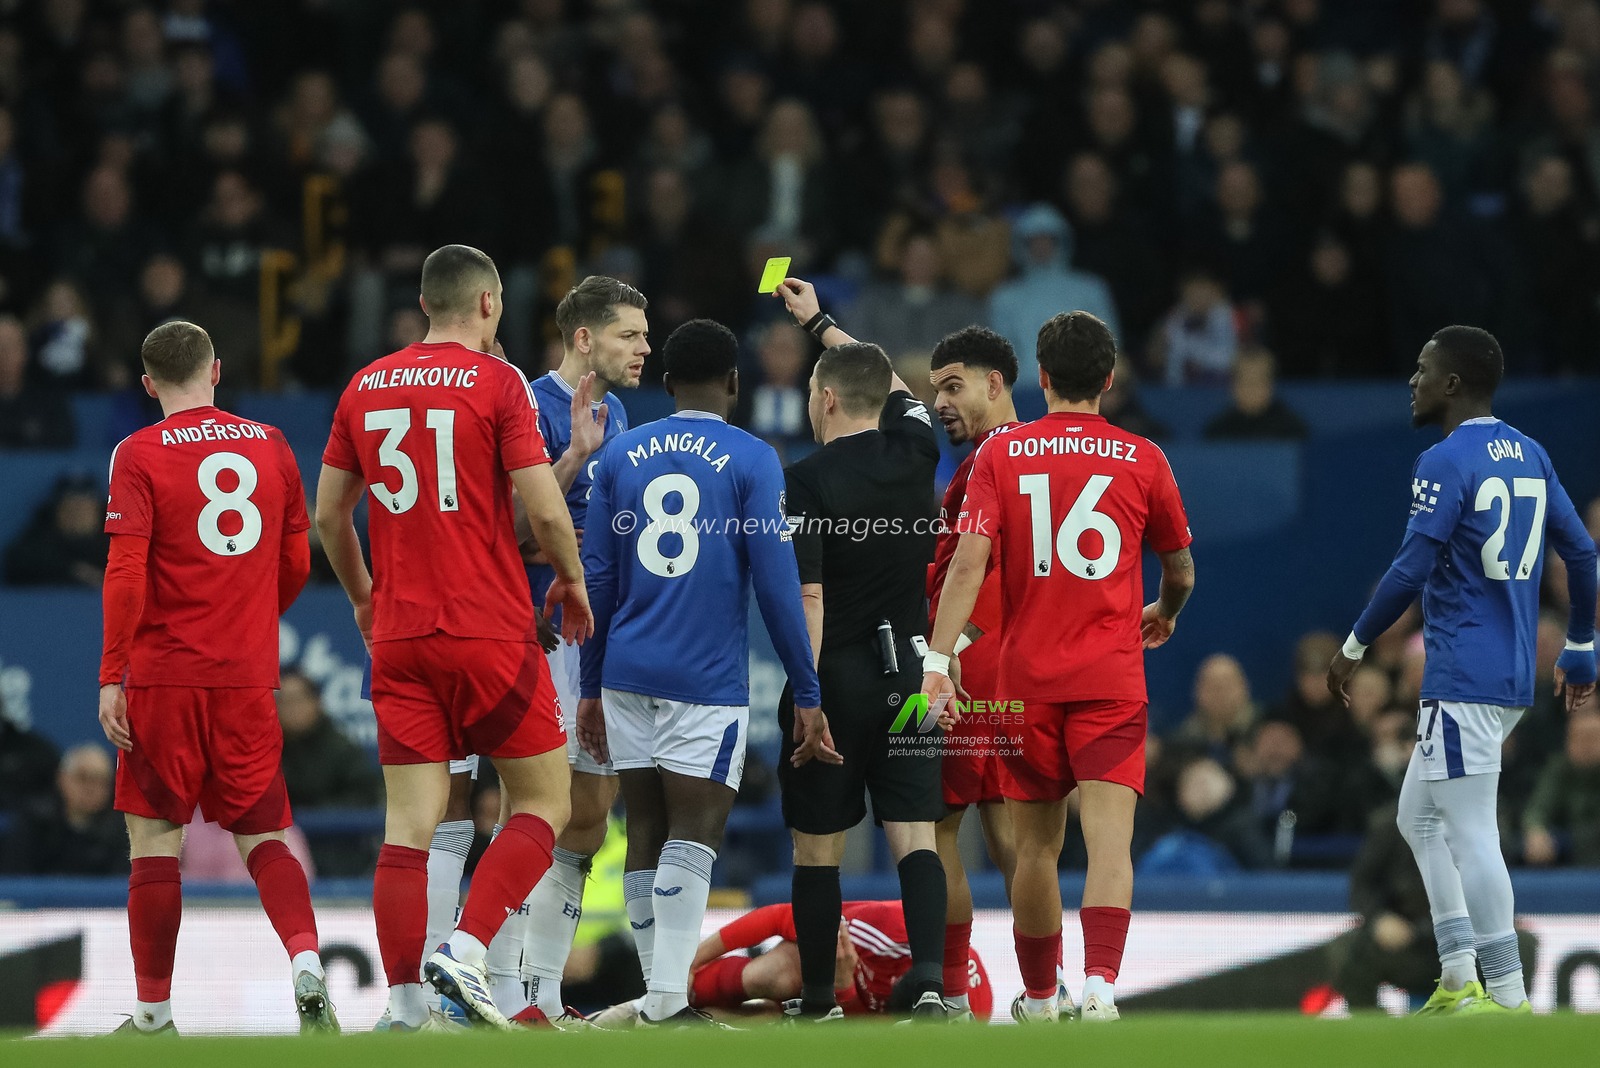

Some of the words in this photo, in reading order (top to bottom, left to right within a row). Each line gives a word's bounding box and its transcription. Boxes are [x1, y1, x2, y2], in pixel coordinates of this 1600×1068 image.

[357, 365, 479, 392] MILENKOVIĆ
[161, 423, 268, 446] ANDERSON
[363, 408, 459, 514] 31
[626, 432, 732, 474] MANGALA
[1008, 436, 1137, 463] DOMINGUEZ
[1487, 439, 1524, 462] GANA
[197, 451, 262, 556] 8
[637, 473, 700, 578] 8
[1018, 473, 1122, 580] 16
[1474, 476, 1547, 580] 27
